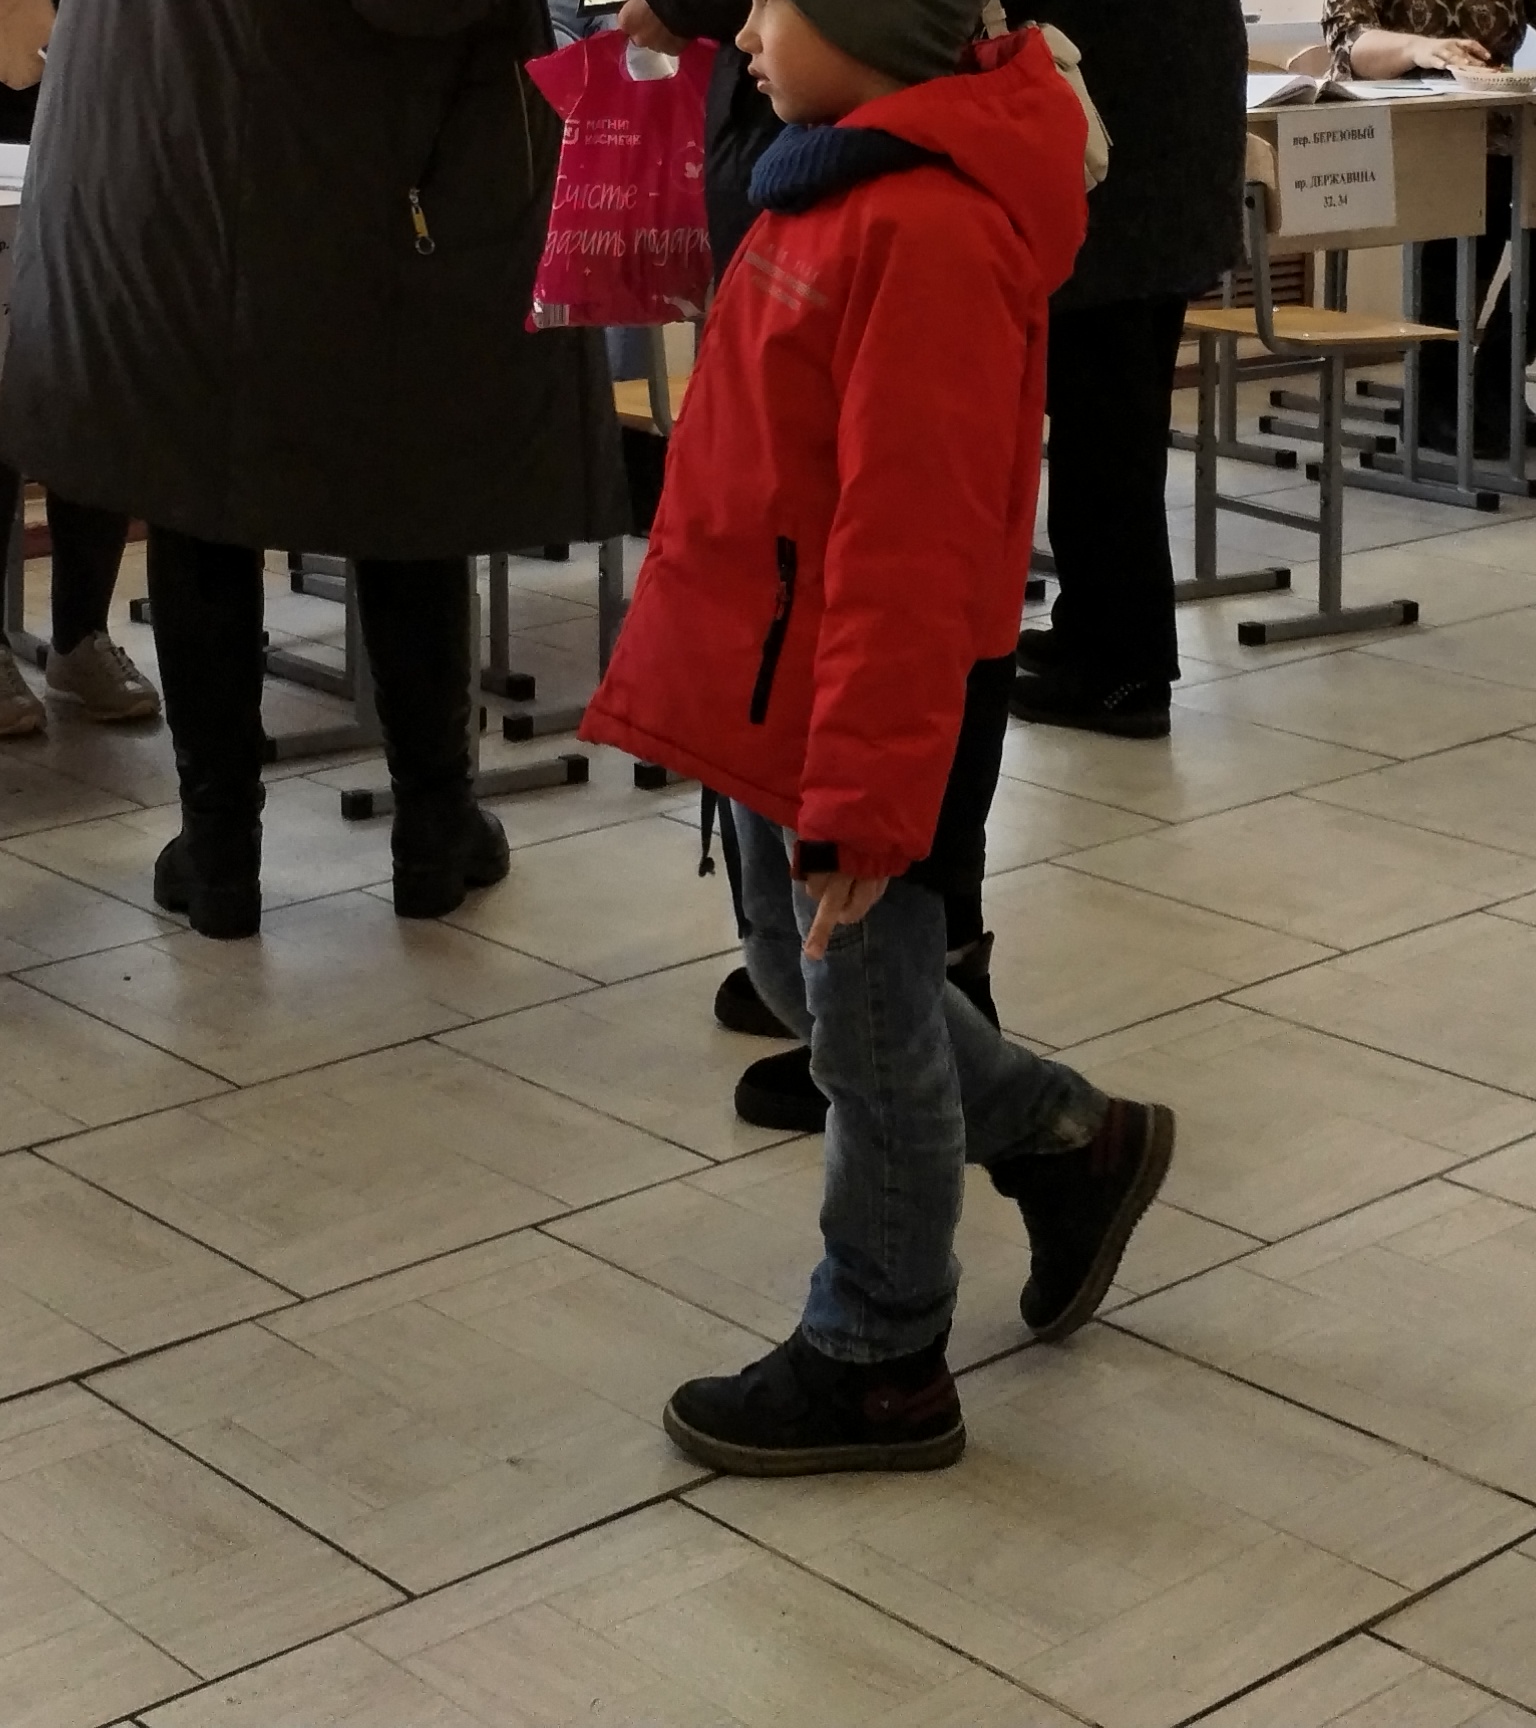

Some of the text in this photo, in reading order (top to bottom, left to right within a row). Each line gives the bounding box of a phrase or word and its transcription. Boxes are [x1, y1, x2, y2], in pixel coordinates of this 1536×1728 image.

[586, 119, 630, 130] МАГНИТ
[1293, 125, 1375, 148] пер. БЕРЕЗОВЫЙ
[1310, 170, 1376, 189] ДЕРЖАВИНА
[544, 227, 711, 270] дарить подарк
